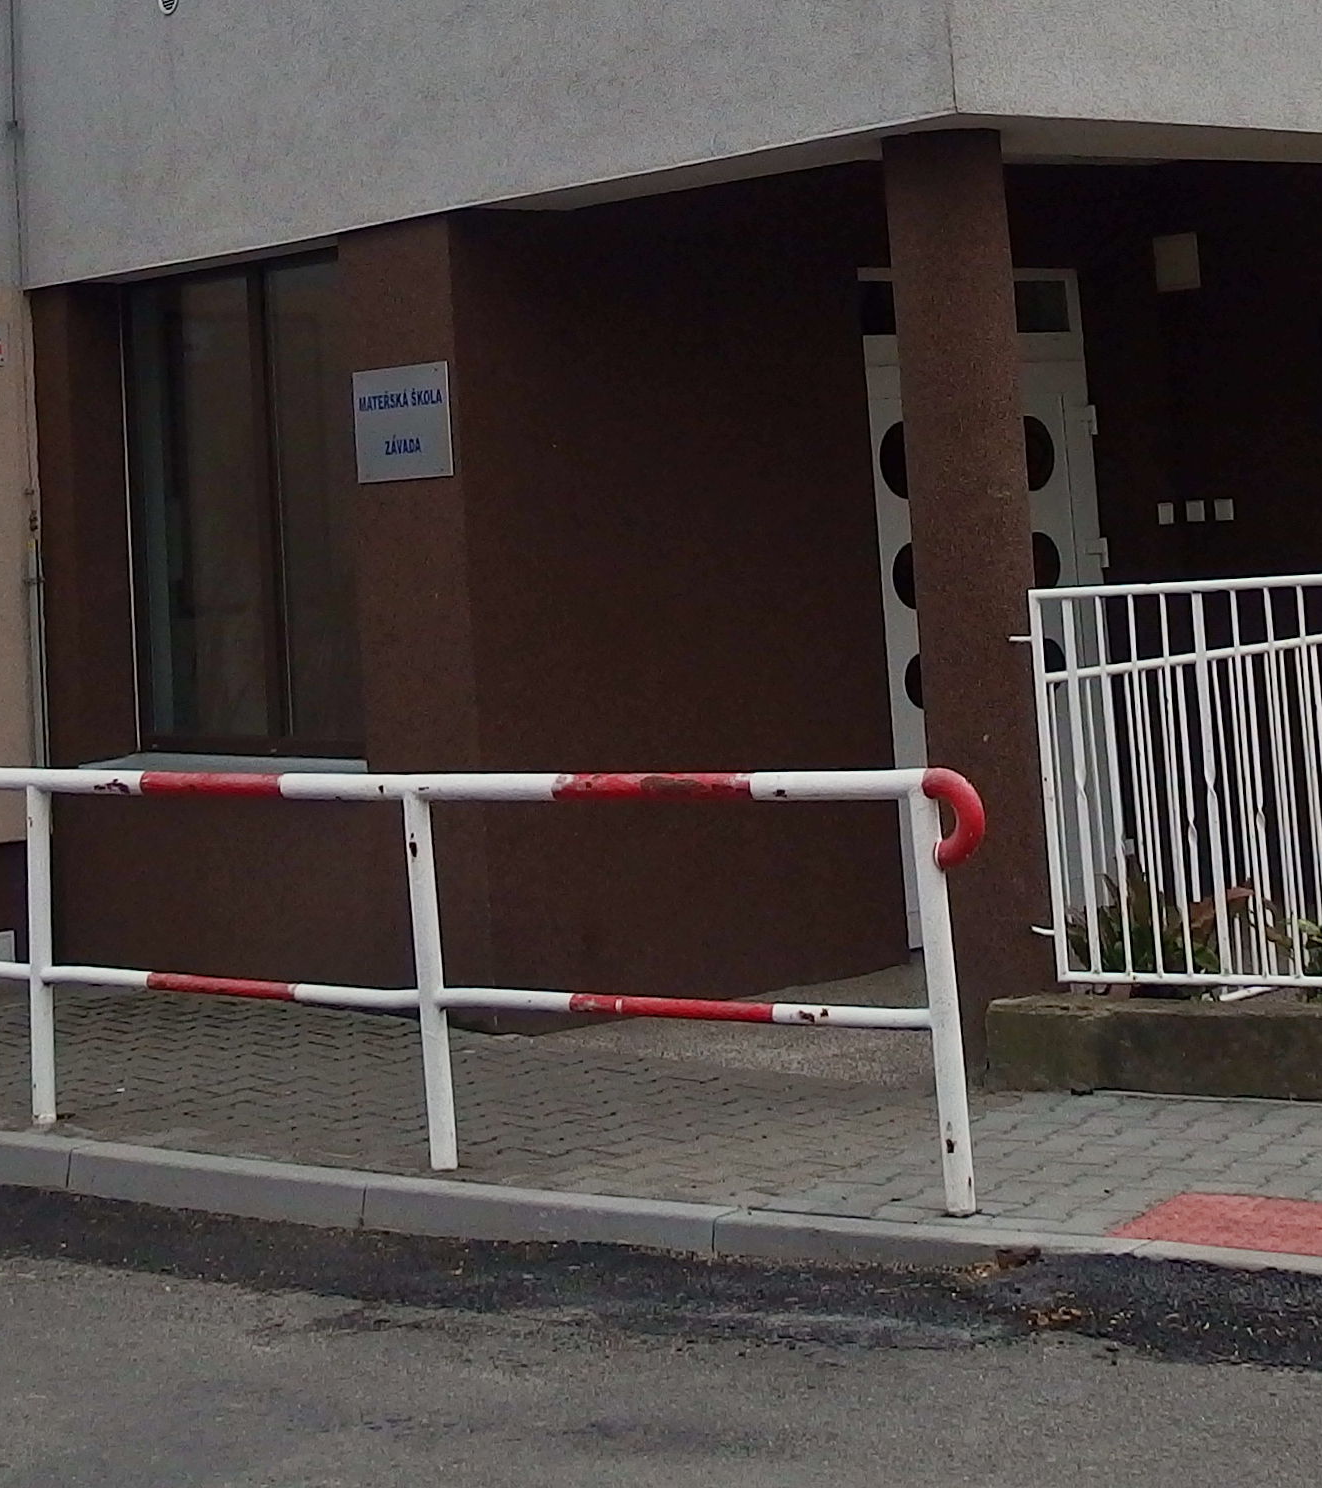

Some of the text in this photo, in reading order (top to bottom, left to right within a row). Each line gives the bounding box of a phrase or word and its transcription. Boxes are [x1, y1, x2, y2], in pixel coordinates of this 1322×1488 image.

[359, 387, 442, 411] MATEŘSKÁ ŠKOLA
[385, 434, 421, 455] ZÁVADA
